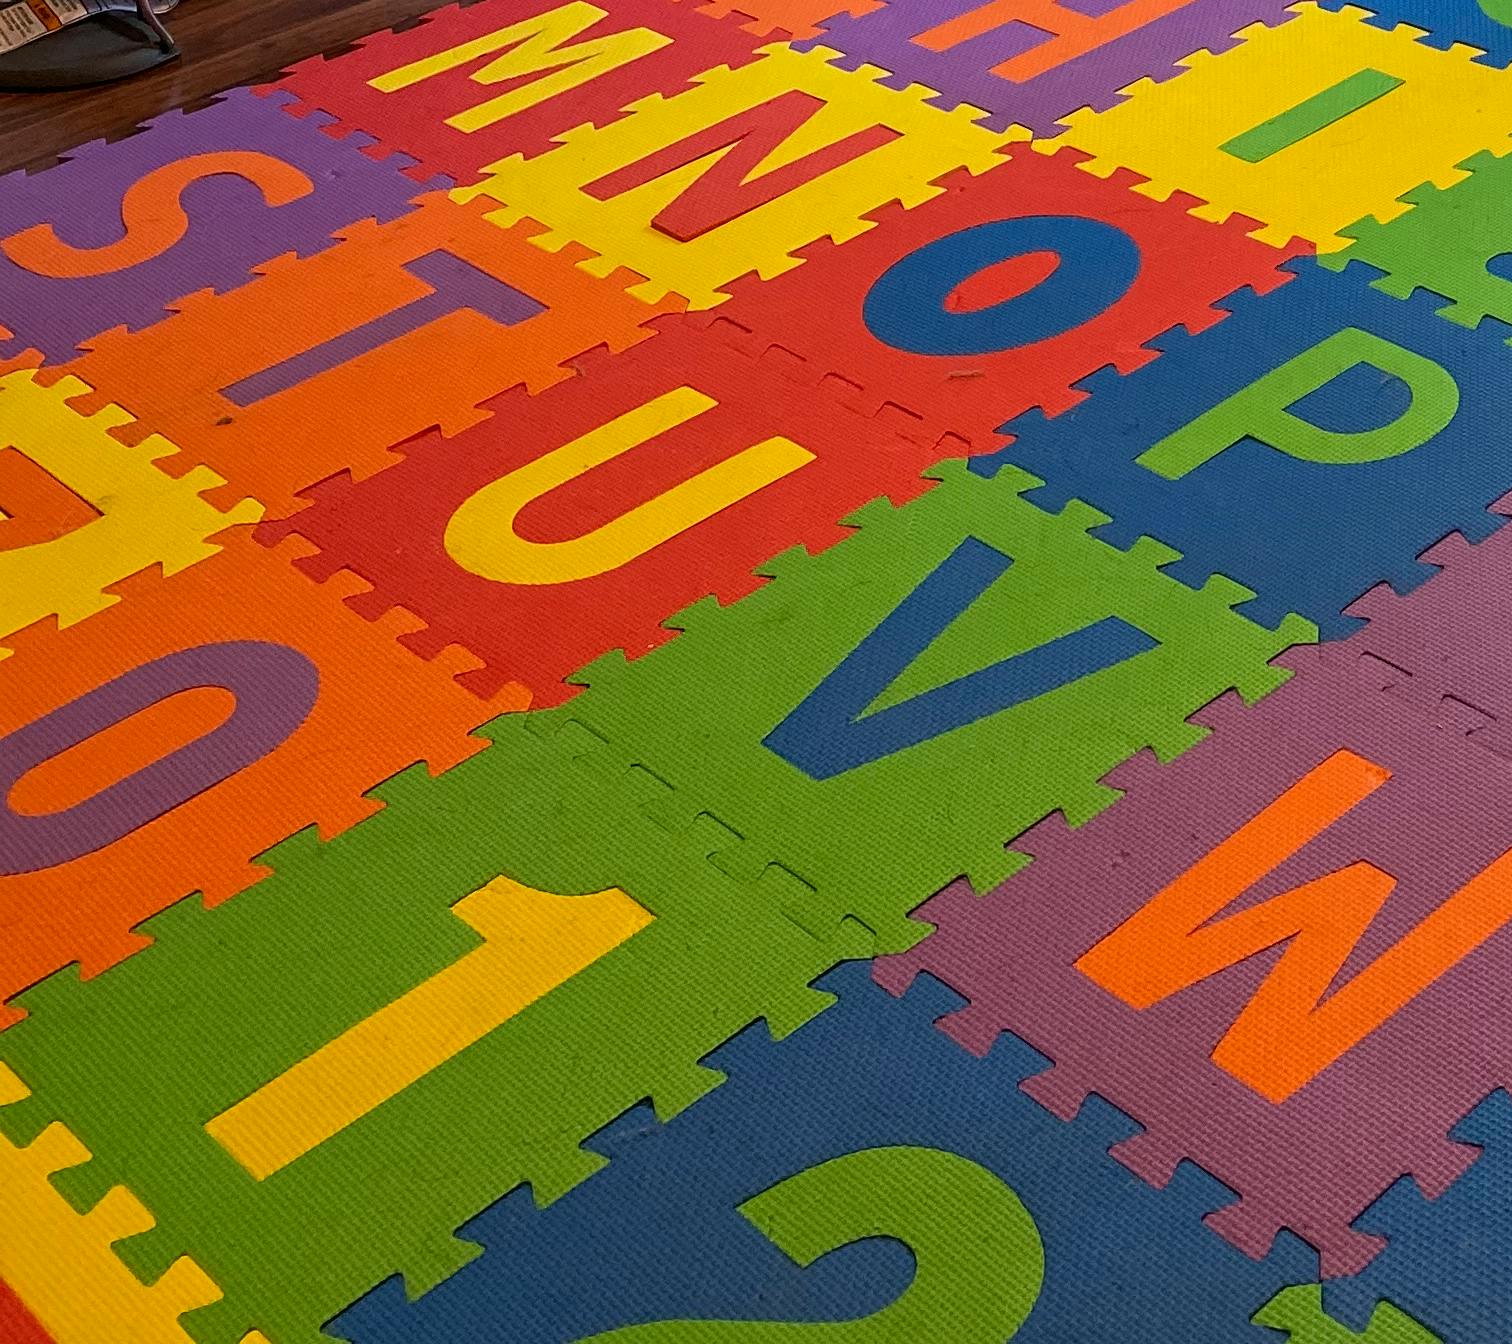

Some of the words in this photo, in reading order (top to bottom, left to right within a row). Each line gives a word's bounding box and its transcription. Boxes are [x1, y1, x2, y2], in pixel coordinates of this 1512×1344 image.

[367, 0, 676, 134] M
[580, 89, 904, 242] N
[863, 215, 1140, 357] O
[1133, 327, 1460, 482] P
[1218, 69, 1405, 163] I
[2, 150, 315, 280] S
[218, 249, 550, 408] T
[443, 386, 817, 586] U
[762, 536, 1160, 780] V
[205, 875, 656, 1181] 1
